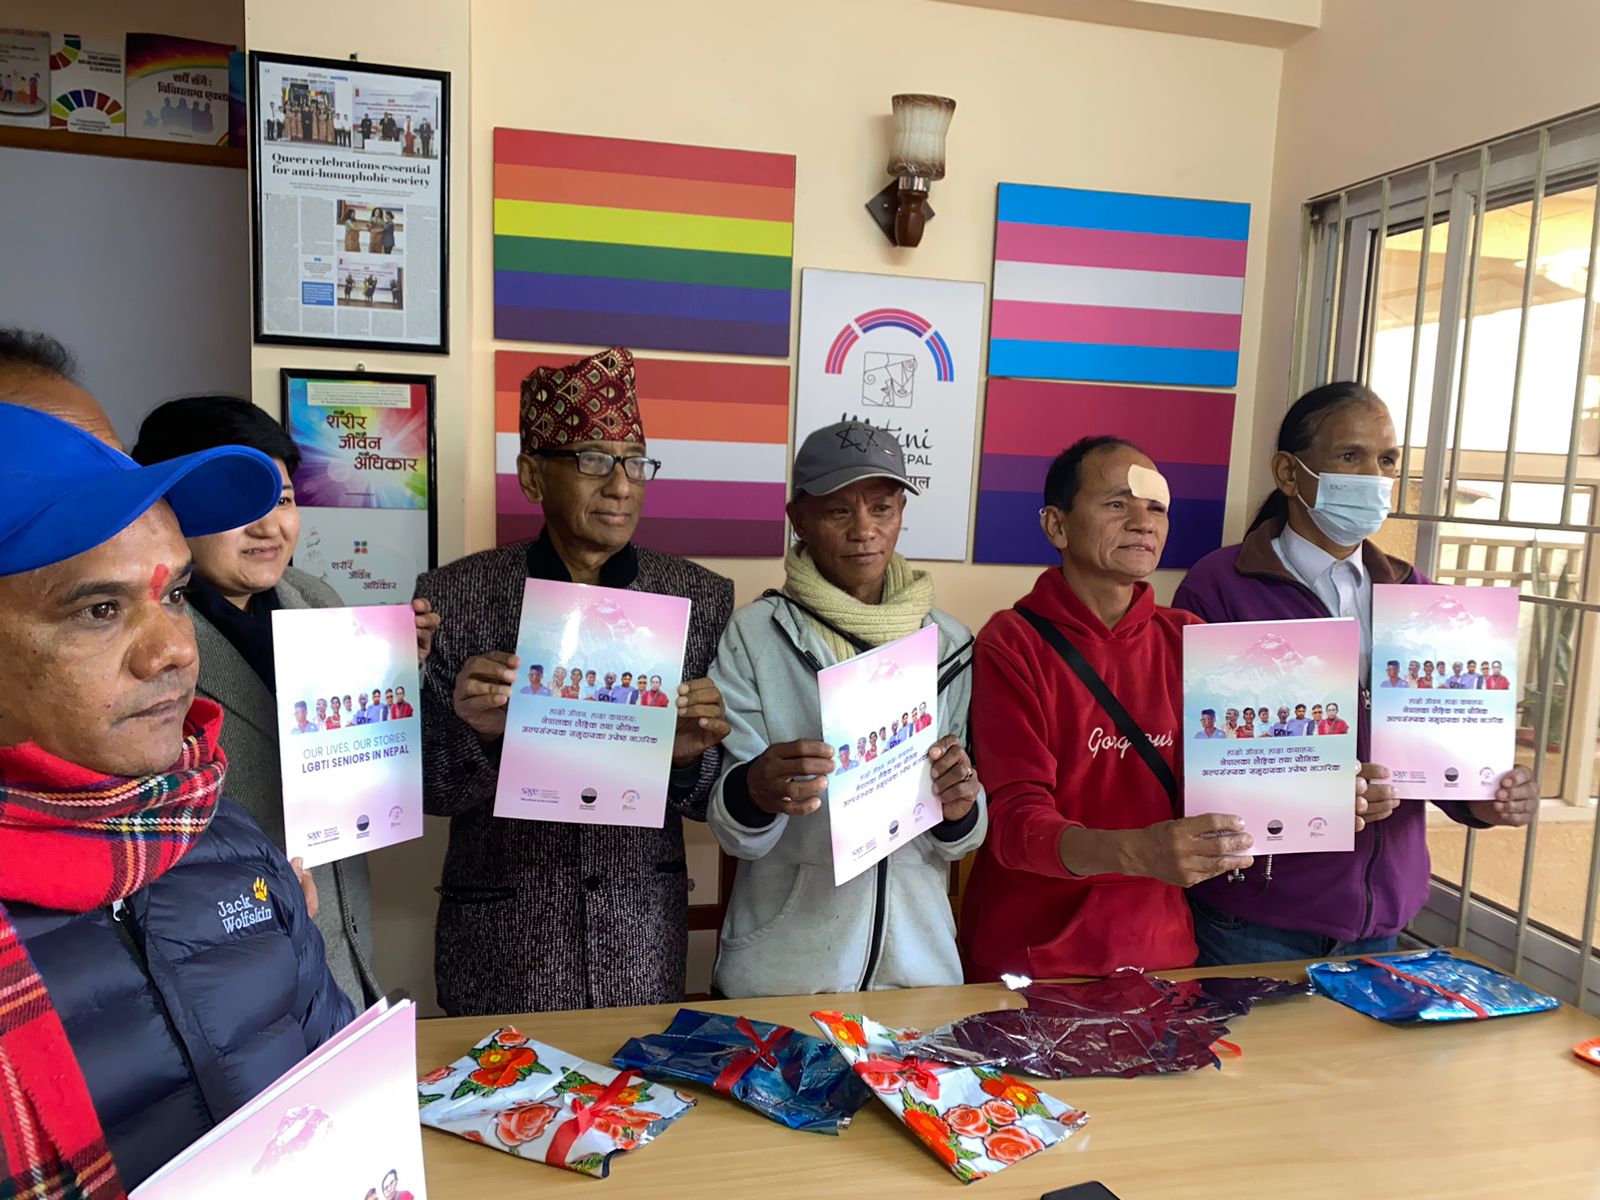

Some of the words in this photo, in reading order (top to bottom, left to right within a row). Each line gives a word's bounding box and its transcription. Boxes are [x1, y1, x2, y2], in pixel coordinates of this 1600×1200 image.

[272, 152, 308, 164] Queer
[310, 154, 380, 170] celebrations
[382, 163, 430, 175] essential
[272, 164, 290, 175] for
[291, 166, 390, 186] anti-homophobic
[392, 172, 430, 188] society
[326, 412, 367, 430] शरीर
[338, 433, 382, 450] जीवन
[354, 453, 418, 472] अधिकार
[302, 759, 330, 774] LGBTI
[332, 753, 370, 768] SENIORS
[372, 750, 382, 760] IN
[383, 745, 410, 759] NEPAL
[303, 748, 324, 760] OUR
[326, 742, 350, 756] LIVES,
[352, 738, 371, 751] OUR
[218, 894, 253, 918] Jack
[222, 906, 272, 934] Wolfskin
